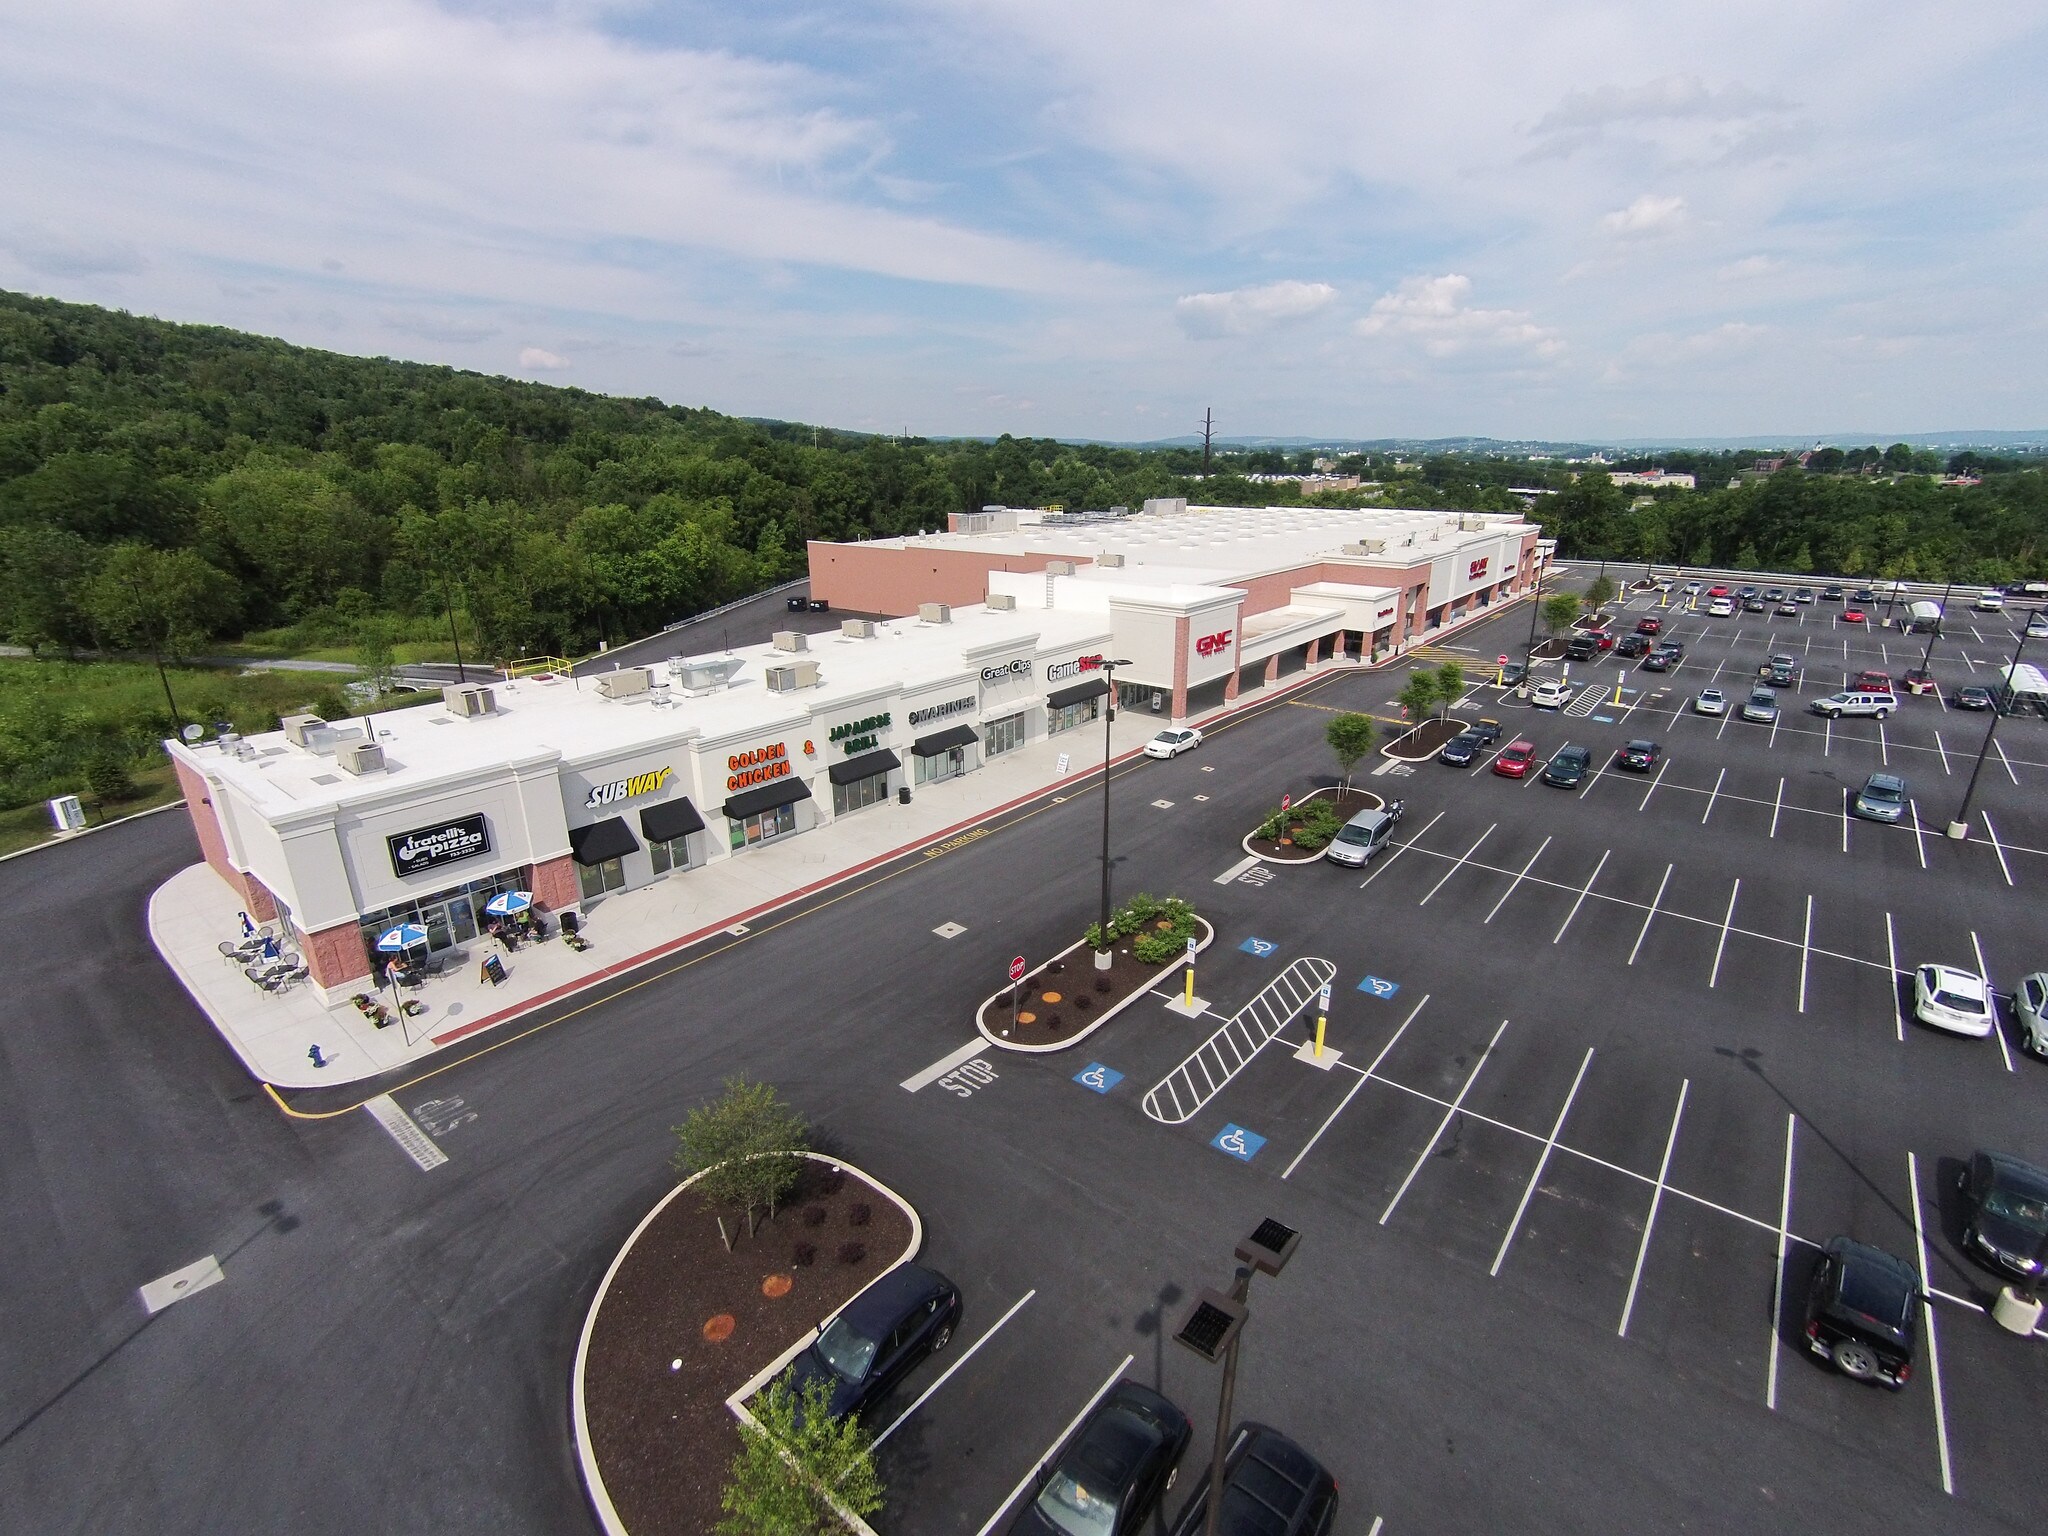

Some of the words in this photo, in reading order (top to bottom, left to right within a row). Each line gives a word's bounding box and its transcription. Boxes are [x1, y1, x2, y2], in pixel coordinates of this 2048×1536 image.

[1195, 629, 1232, 653] GNC
[980, 664, 1009, 681] Great
[1010, 660, 1031, 673] Clips
[917, 695, 977, 723] MARINES
[829, 712, 891, 742] JAPANESE
[728, 742, 785, 771] GOLDEN
[803, 740, 815, 755] &
[844, 734, 879, 755] GRILL
[585, 766, 673, 809] SUBWAY
[727, 760, 791, 791] CHICKEN
[406, 827, 466, 850] fratelli's
[923, 847, 943, 858] NO
[941, 828, 989, 849] PARKING
[1010, 962, 1025, 976] STOP
[938, 1058, 999, 1098] STOP
